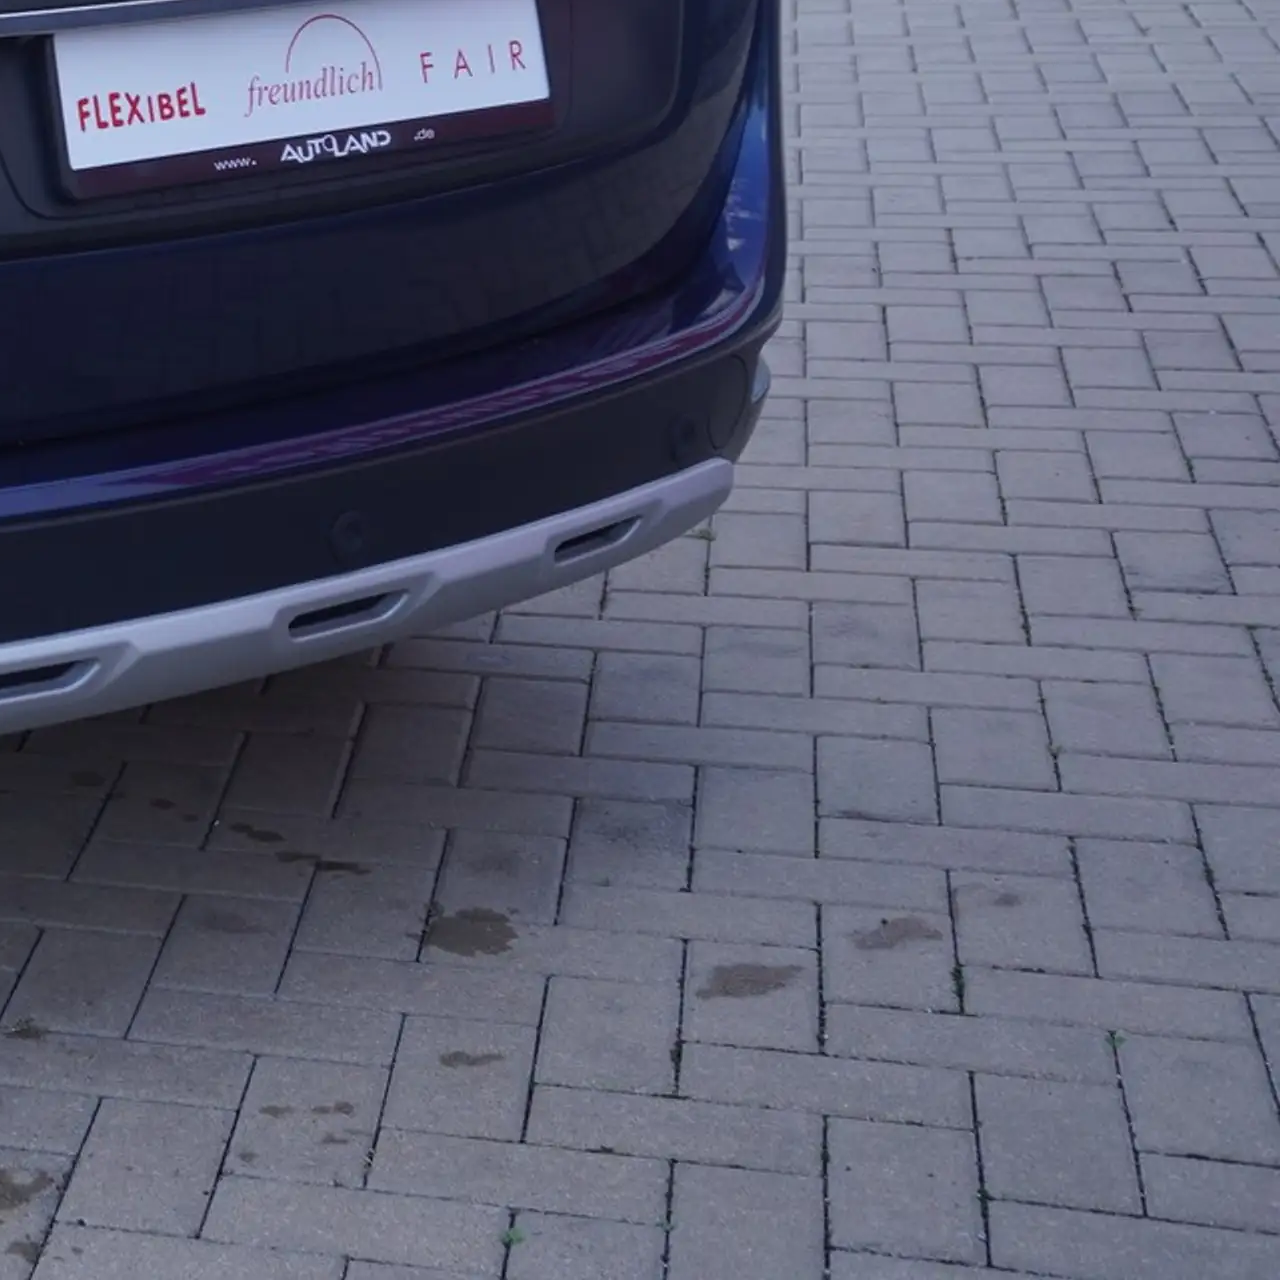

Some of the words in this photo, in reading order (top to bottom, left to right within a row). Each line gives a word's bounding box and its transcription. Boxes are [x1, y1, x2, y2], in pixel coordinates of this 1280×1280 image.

[76, 82, 207, 132] FLEXIBEL
[244, 62, 376, 118] freundlich
[419, 39, 527, 83] FAIR
